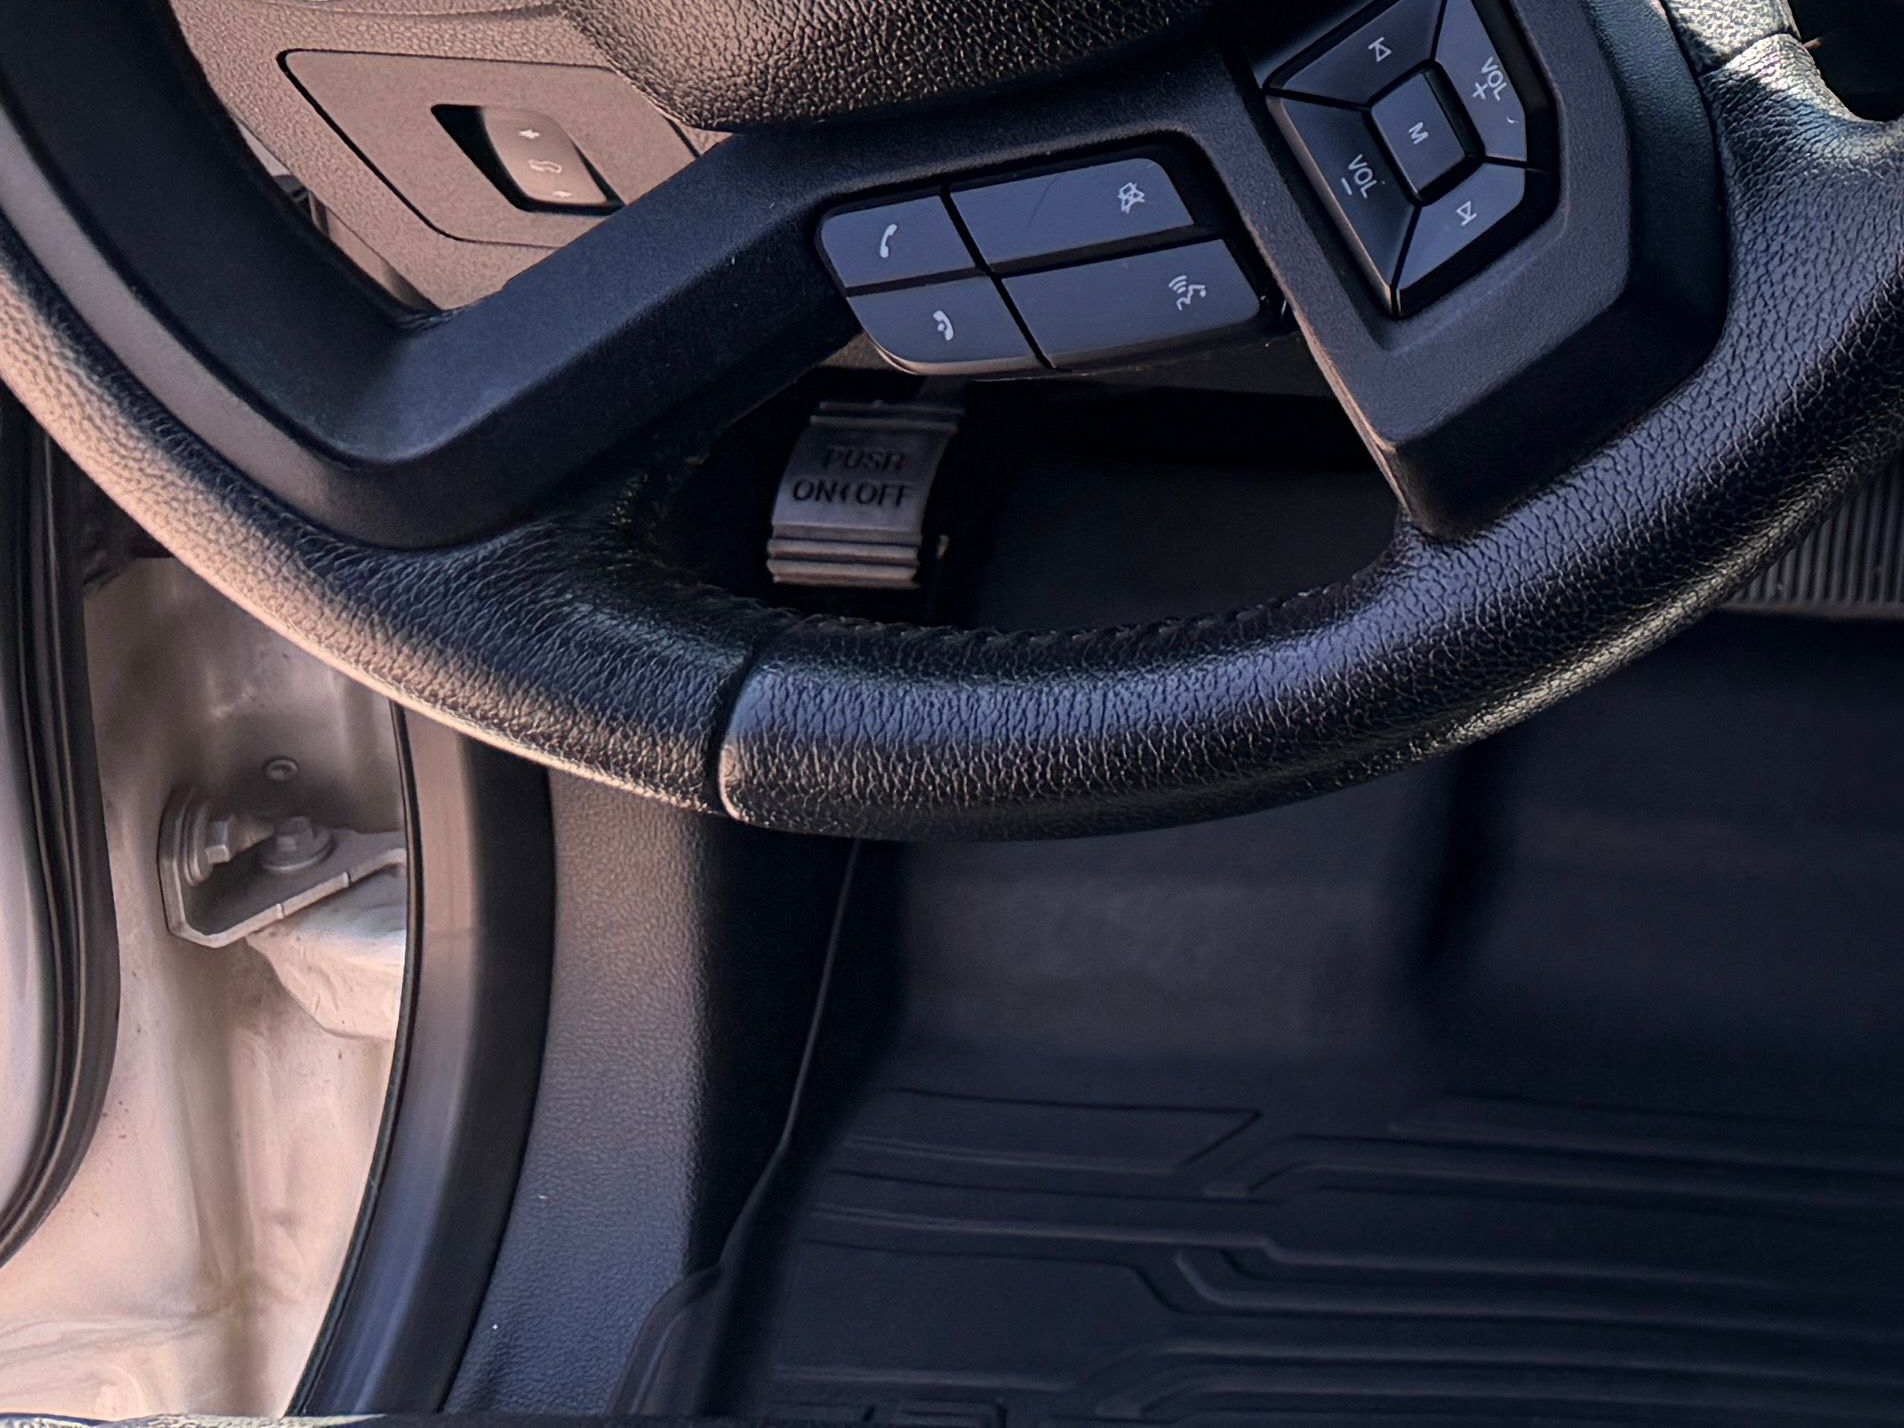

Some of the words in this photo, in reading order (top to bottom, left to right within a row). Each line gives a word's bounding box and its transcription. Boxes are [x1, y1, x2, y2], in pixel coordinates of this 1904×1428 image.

[1480, 56, 1508, 101] VOL
[1408, 121, 1430, 145] M
[1347, 153, 1378, 200] VOL
